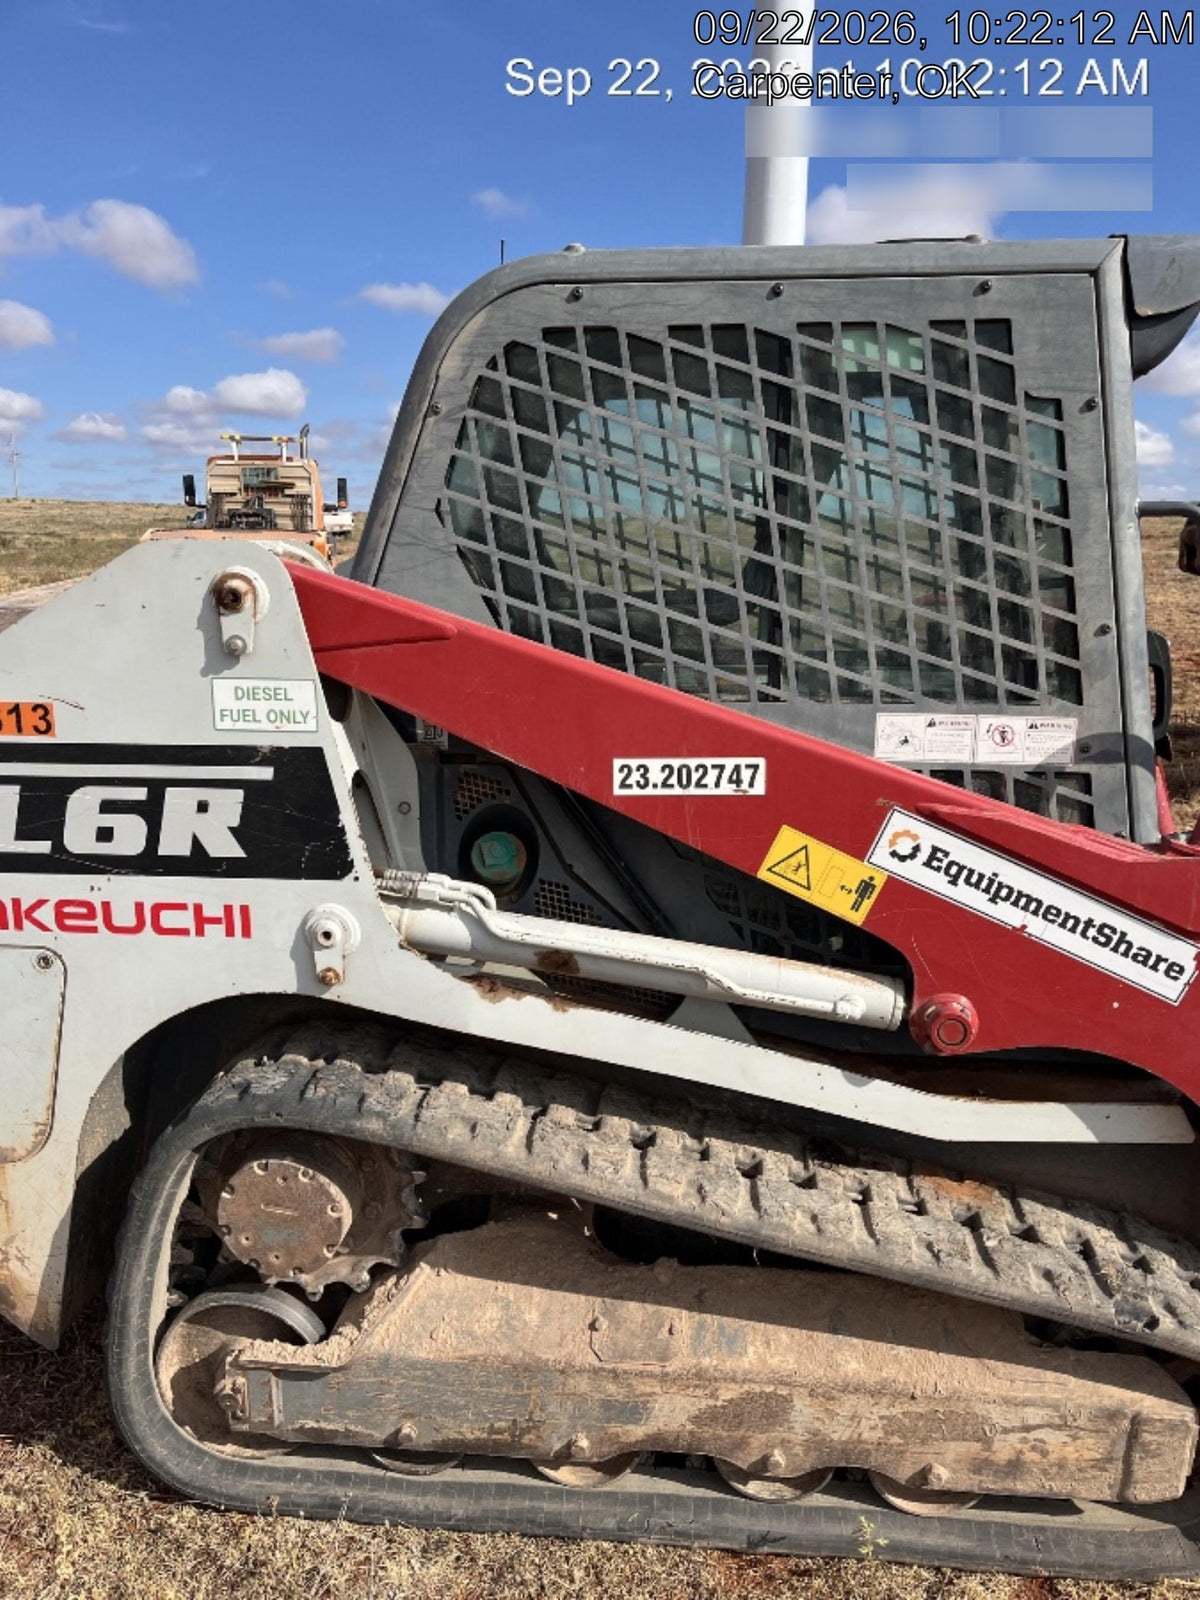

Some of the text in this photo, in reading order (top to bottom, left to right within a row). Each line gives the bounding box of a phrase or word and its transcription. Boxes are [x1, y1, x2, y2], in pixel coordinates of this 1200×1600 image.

[234, 685, 294, 702] DIESEL
[0, 703, 53, 735] 13
[219, 708, 310, 725] FUEL ONLY
[618, 763, 760, 789] 23.202747
[921, 843, 1186, 982] EquipmentShare
